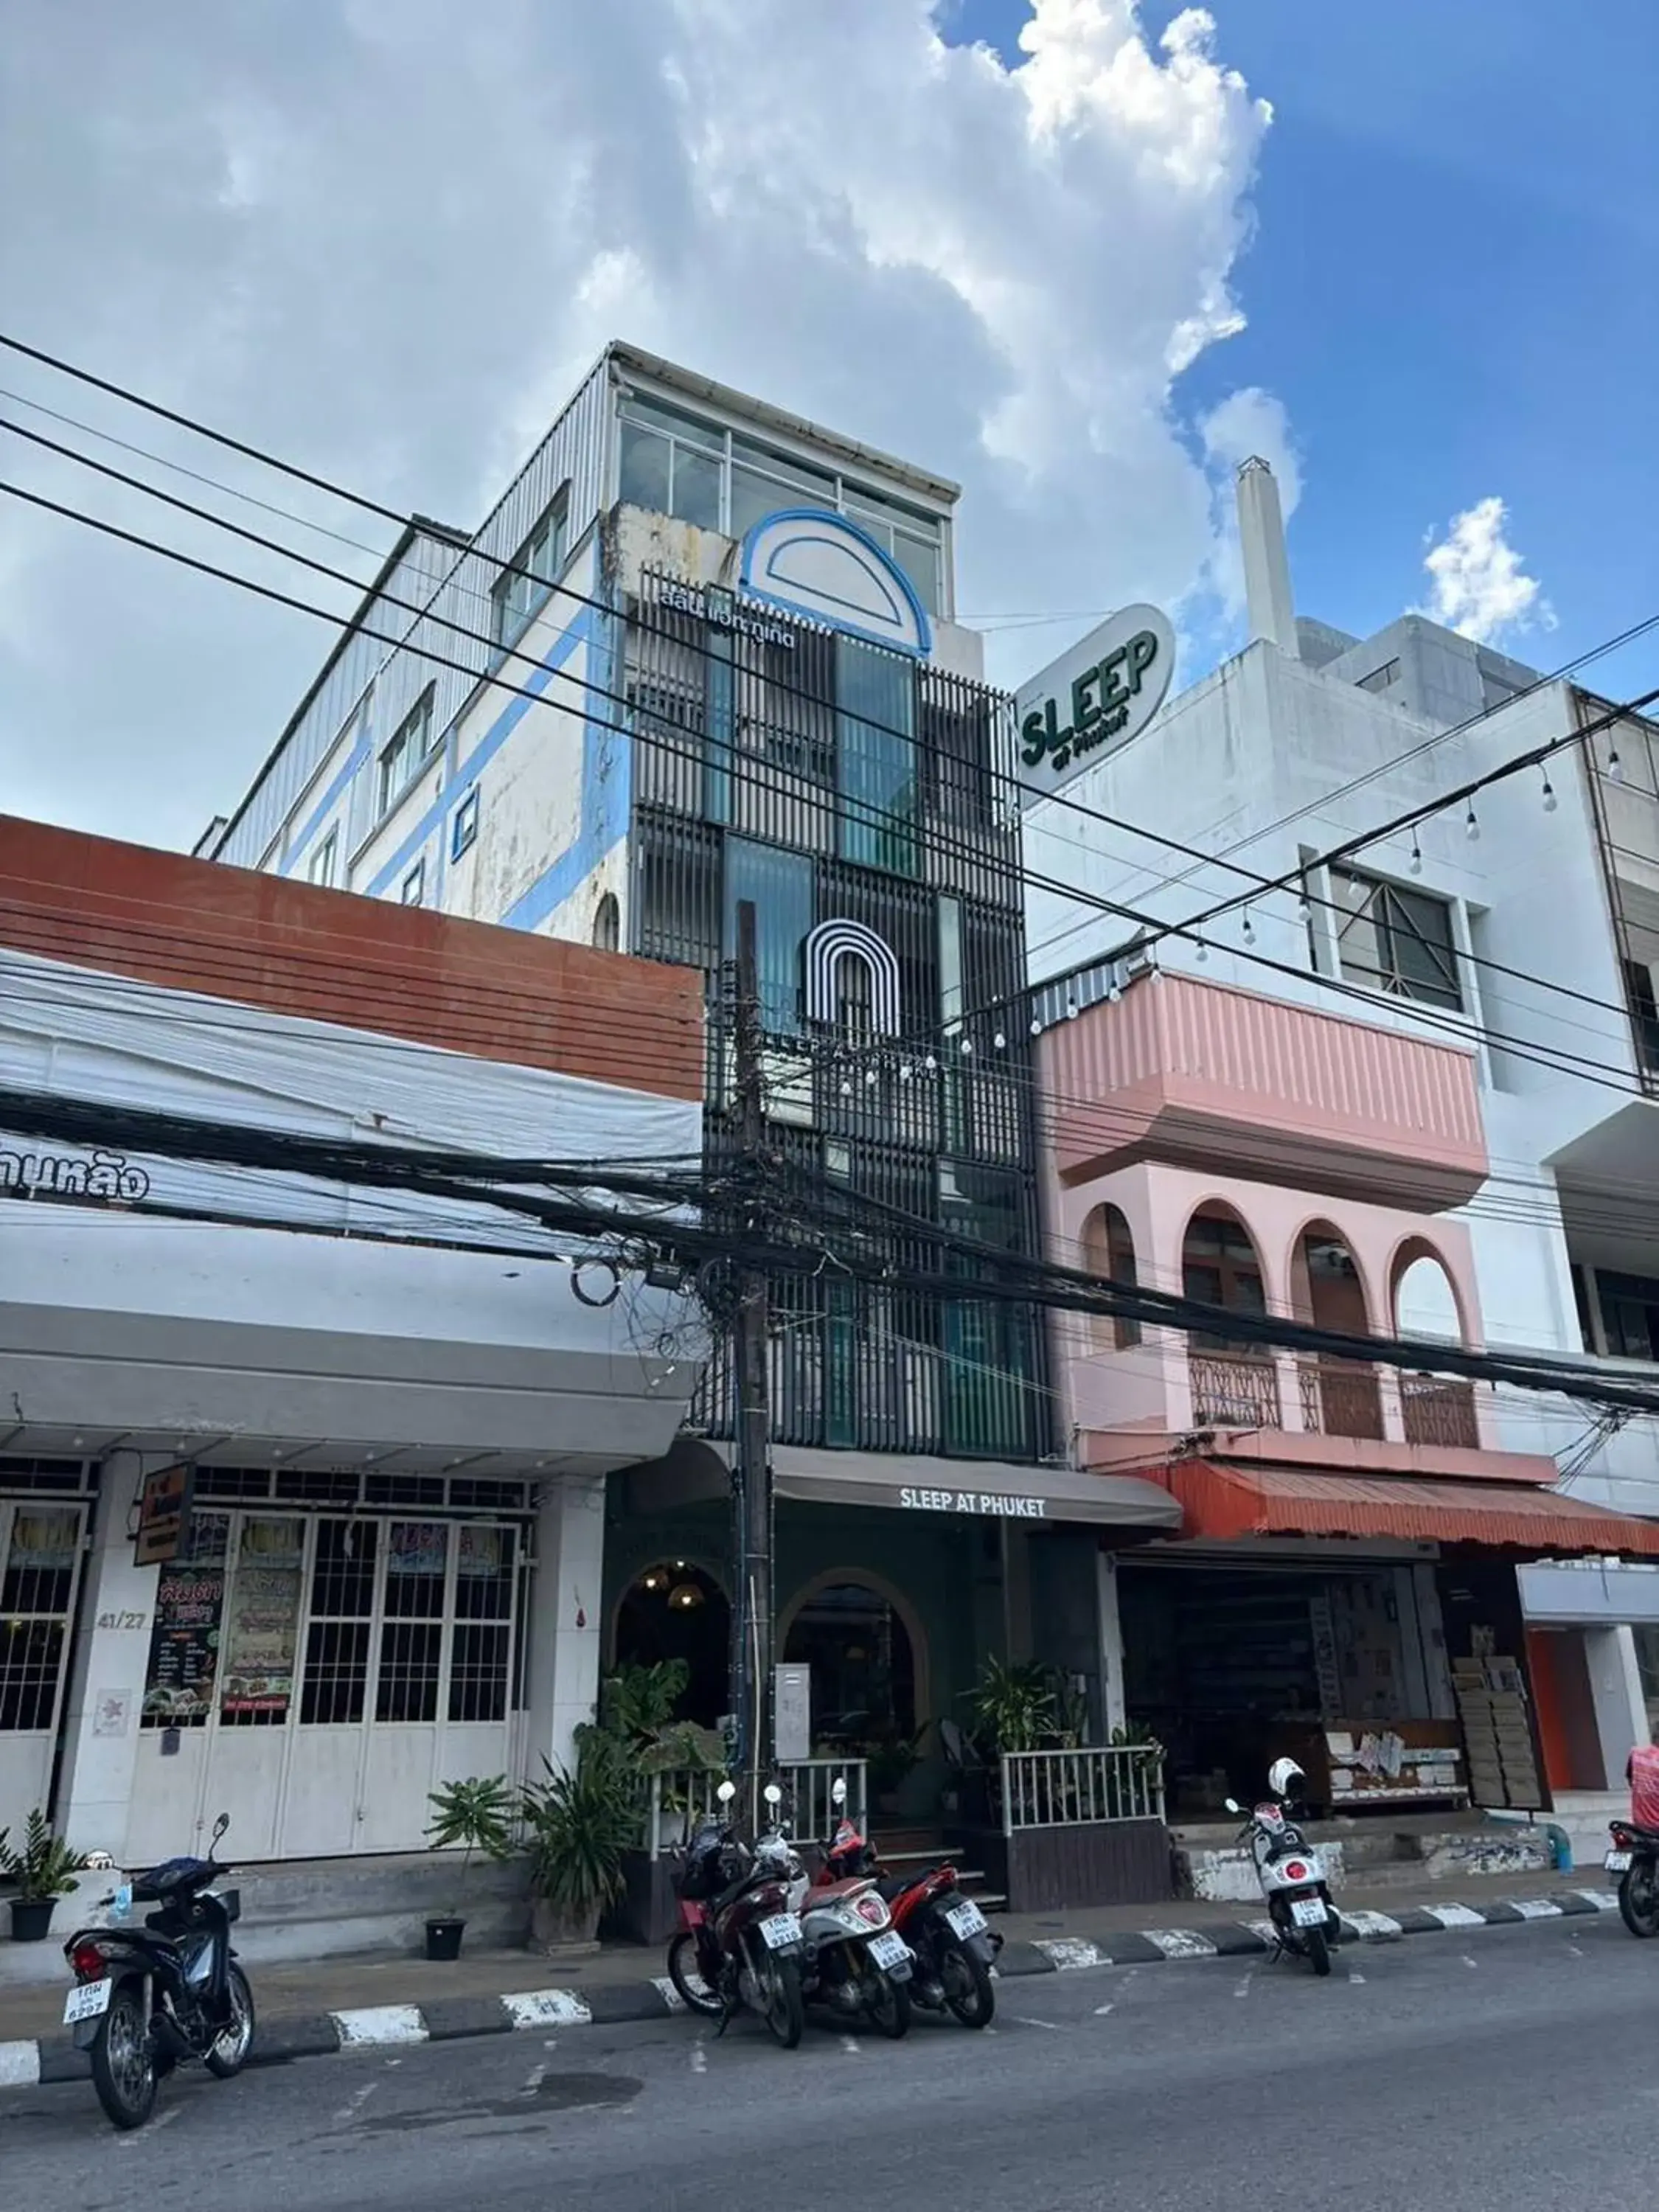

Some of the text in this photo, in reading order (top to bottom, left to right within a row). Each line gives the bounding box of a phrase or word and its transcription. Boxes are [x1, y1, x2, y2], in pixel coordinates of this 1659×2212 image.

[1021, 630, 1158, 768] SLEEP
[1052, 705, 1130, 772] at Phuket
[900, 1487, 1046, 1517] SLEEP AT PHUKET
[97, 1610, 146, 1630] 41/27
